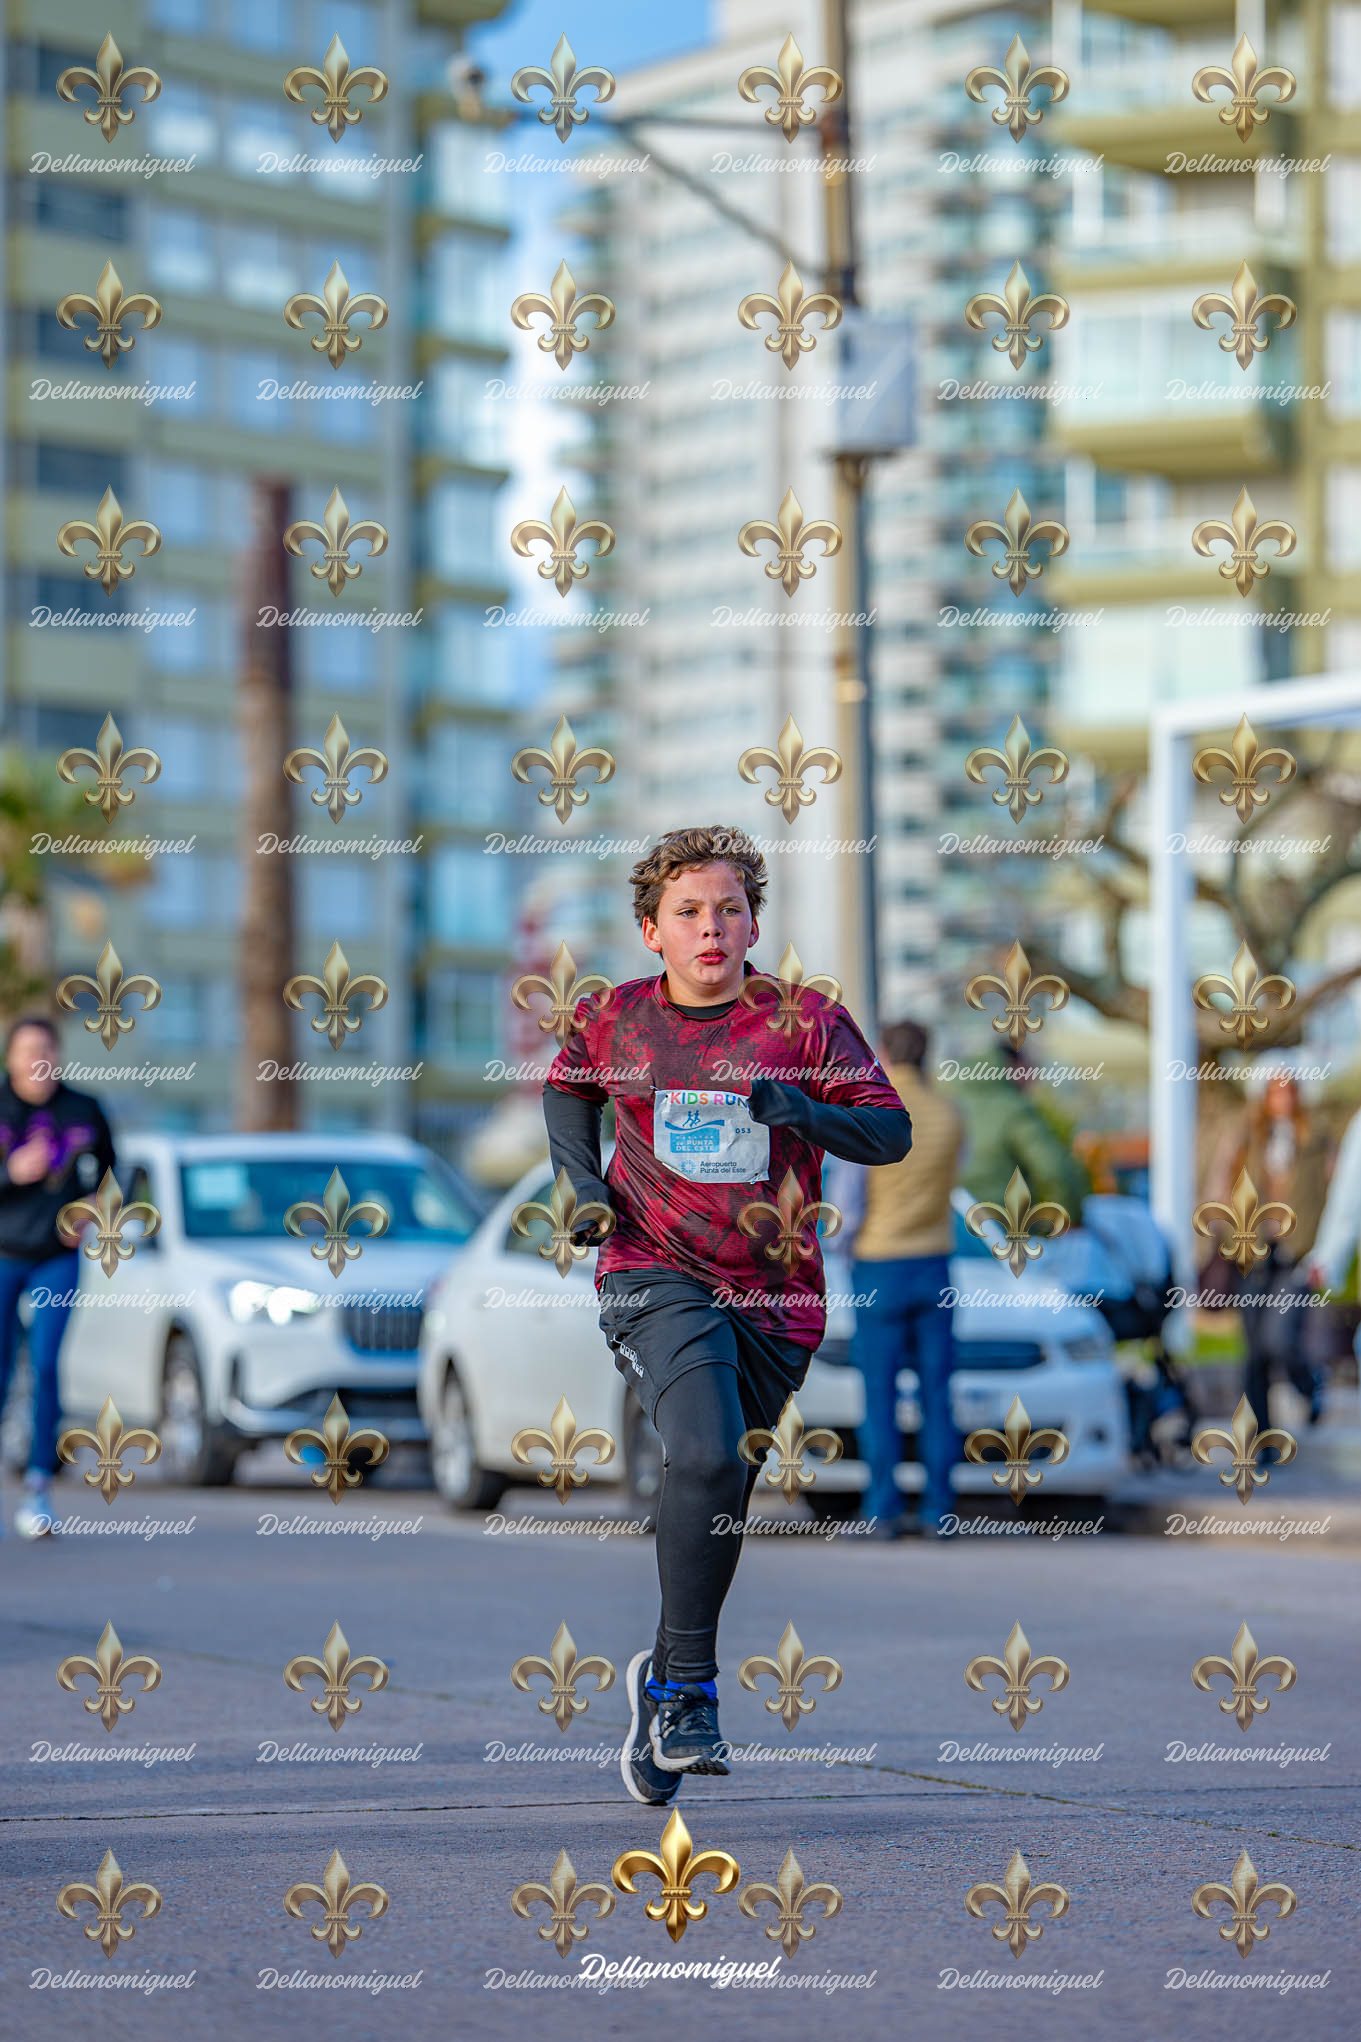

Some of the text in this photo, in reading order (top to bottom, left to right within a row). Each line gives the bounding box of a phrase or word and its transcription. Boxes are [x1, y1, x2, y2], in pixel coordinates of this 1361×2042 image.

[670, 1092, 748, 1109] KIDS RUN
[735, 1127, 751, 1135] 053
